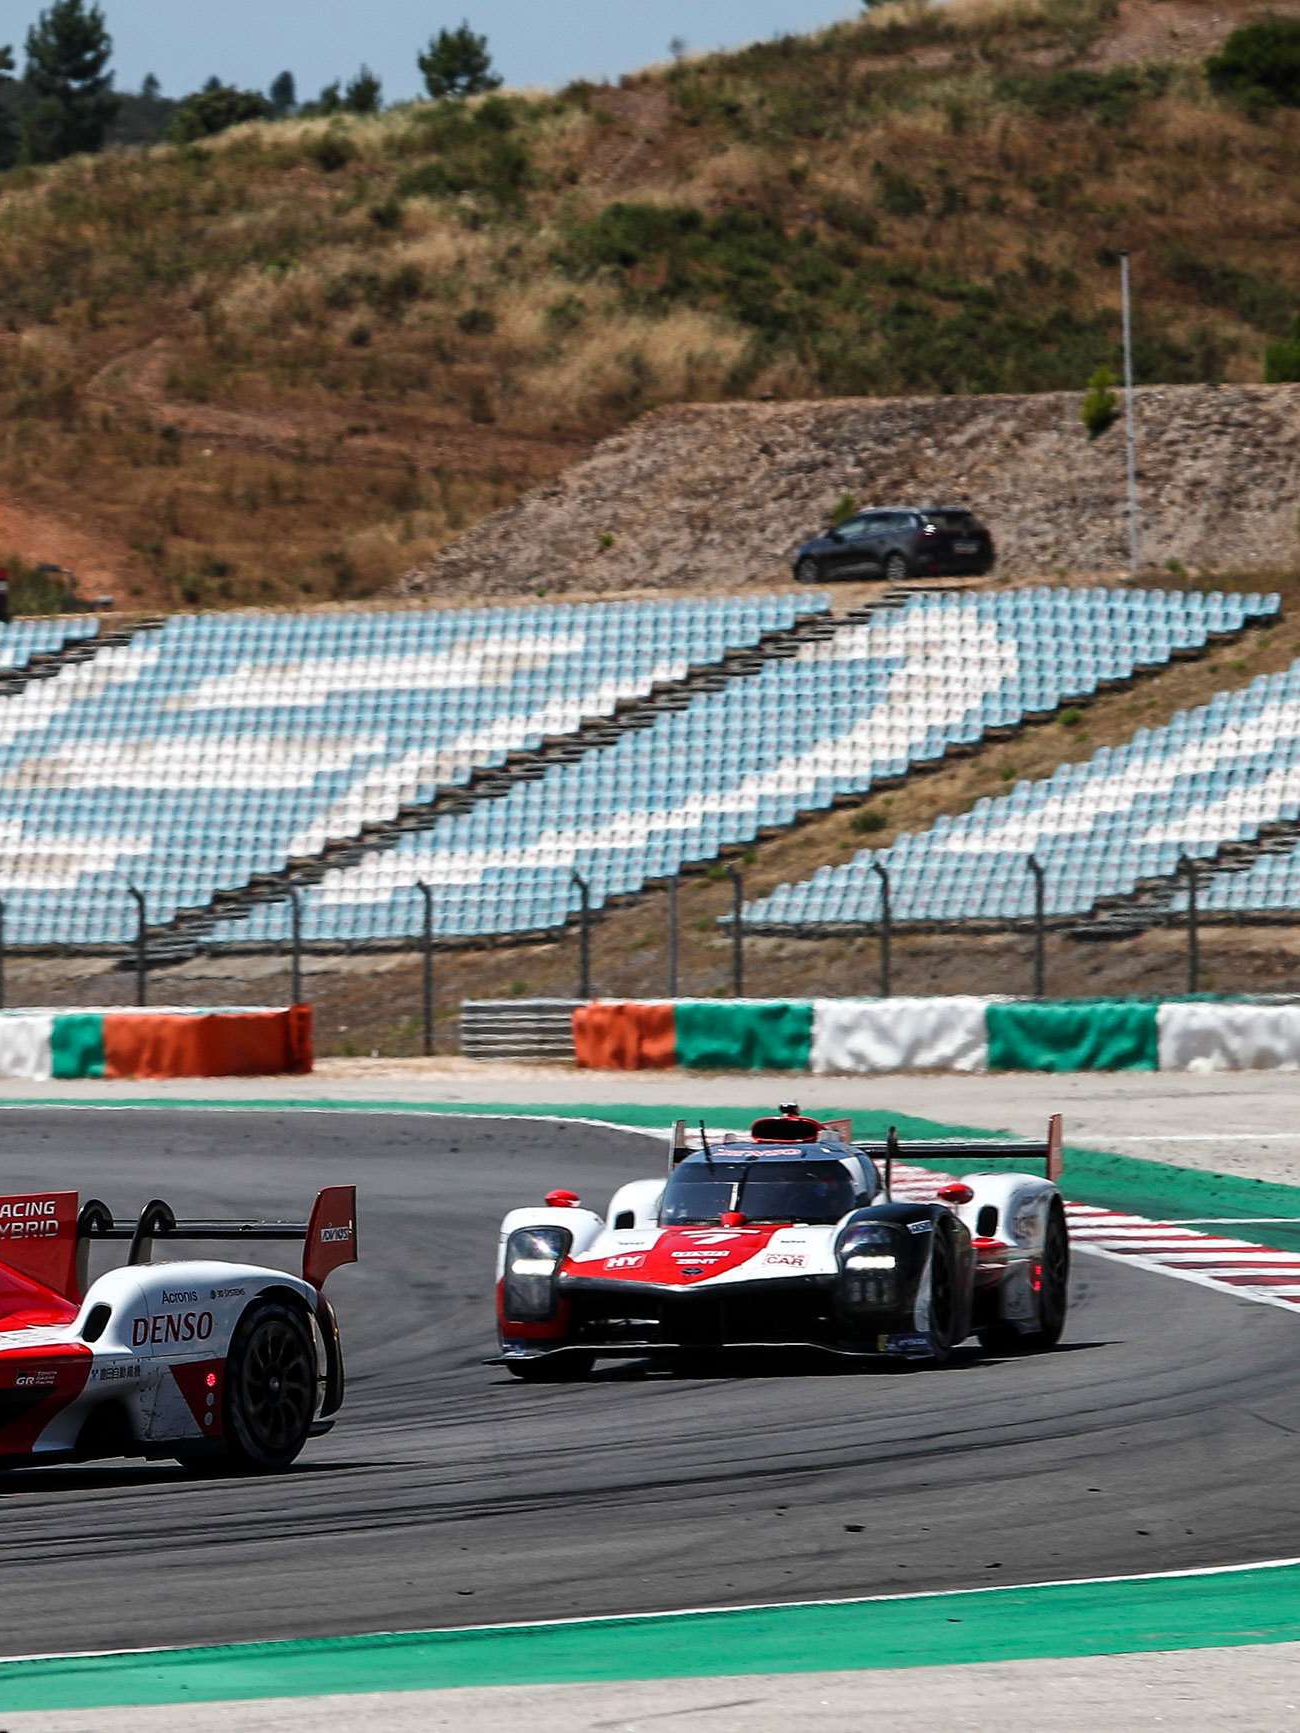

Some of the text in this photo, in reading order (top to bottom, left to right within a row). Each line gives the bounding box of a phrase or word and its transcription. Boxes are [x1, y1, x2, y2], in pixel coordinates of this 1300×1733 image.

[606, 1255, 642, 1268] HY
[767, 1256, 804, 1266] CAR
[161, 1289, 198, 1304] Acronis
[131, 1311, 213, 1346] DENSO
[16, 1376, 35, 1385] GR
